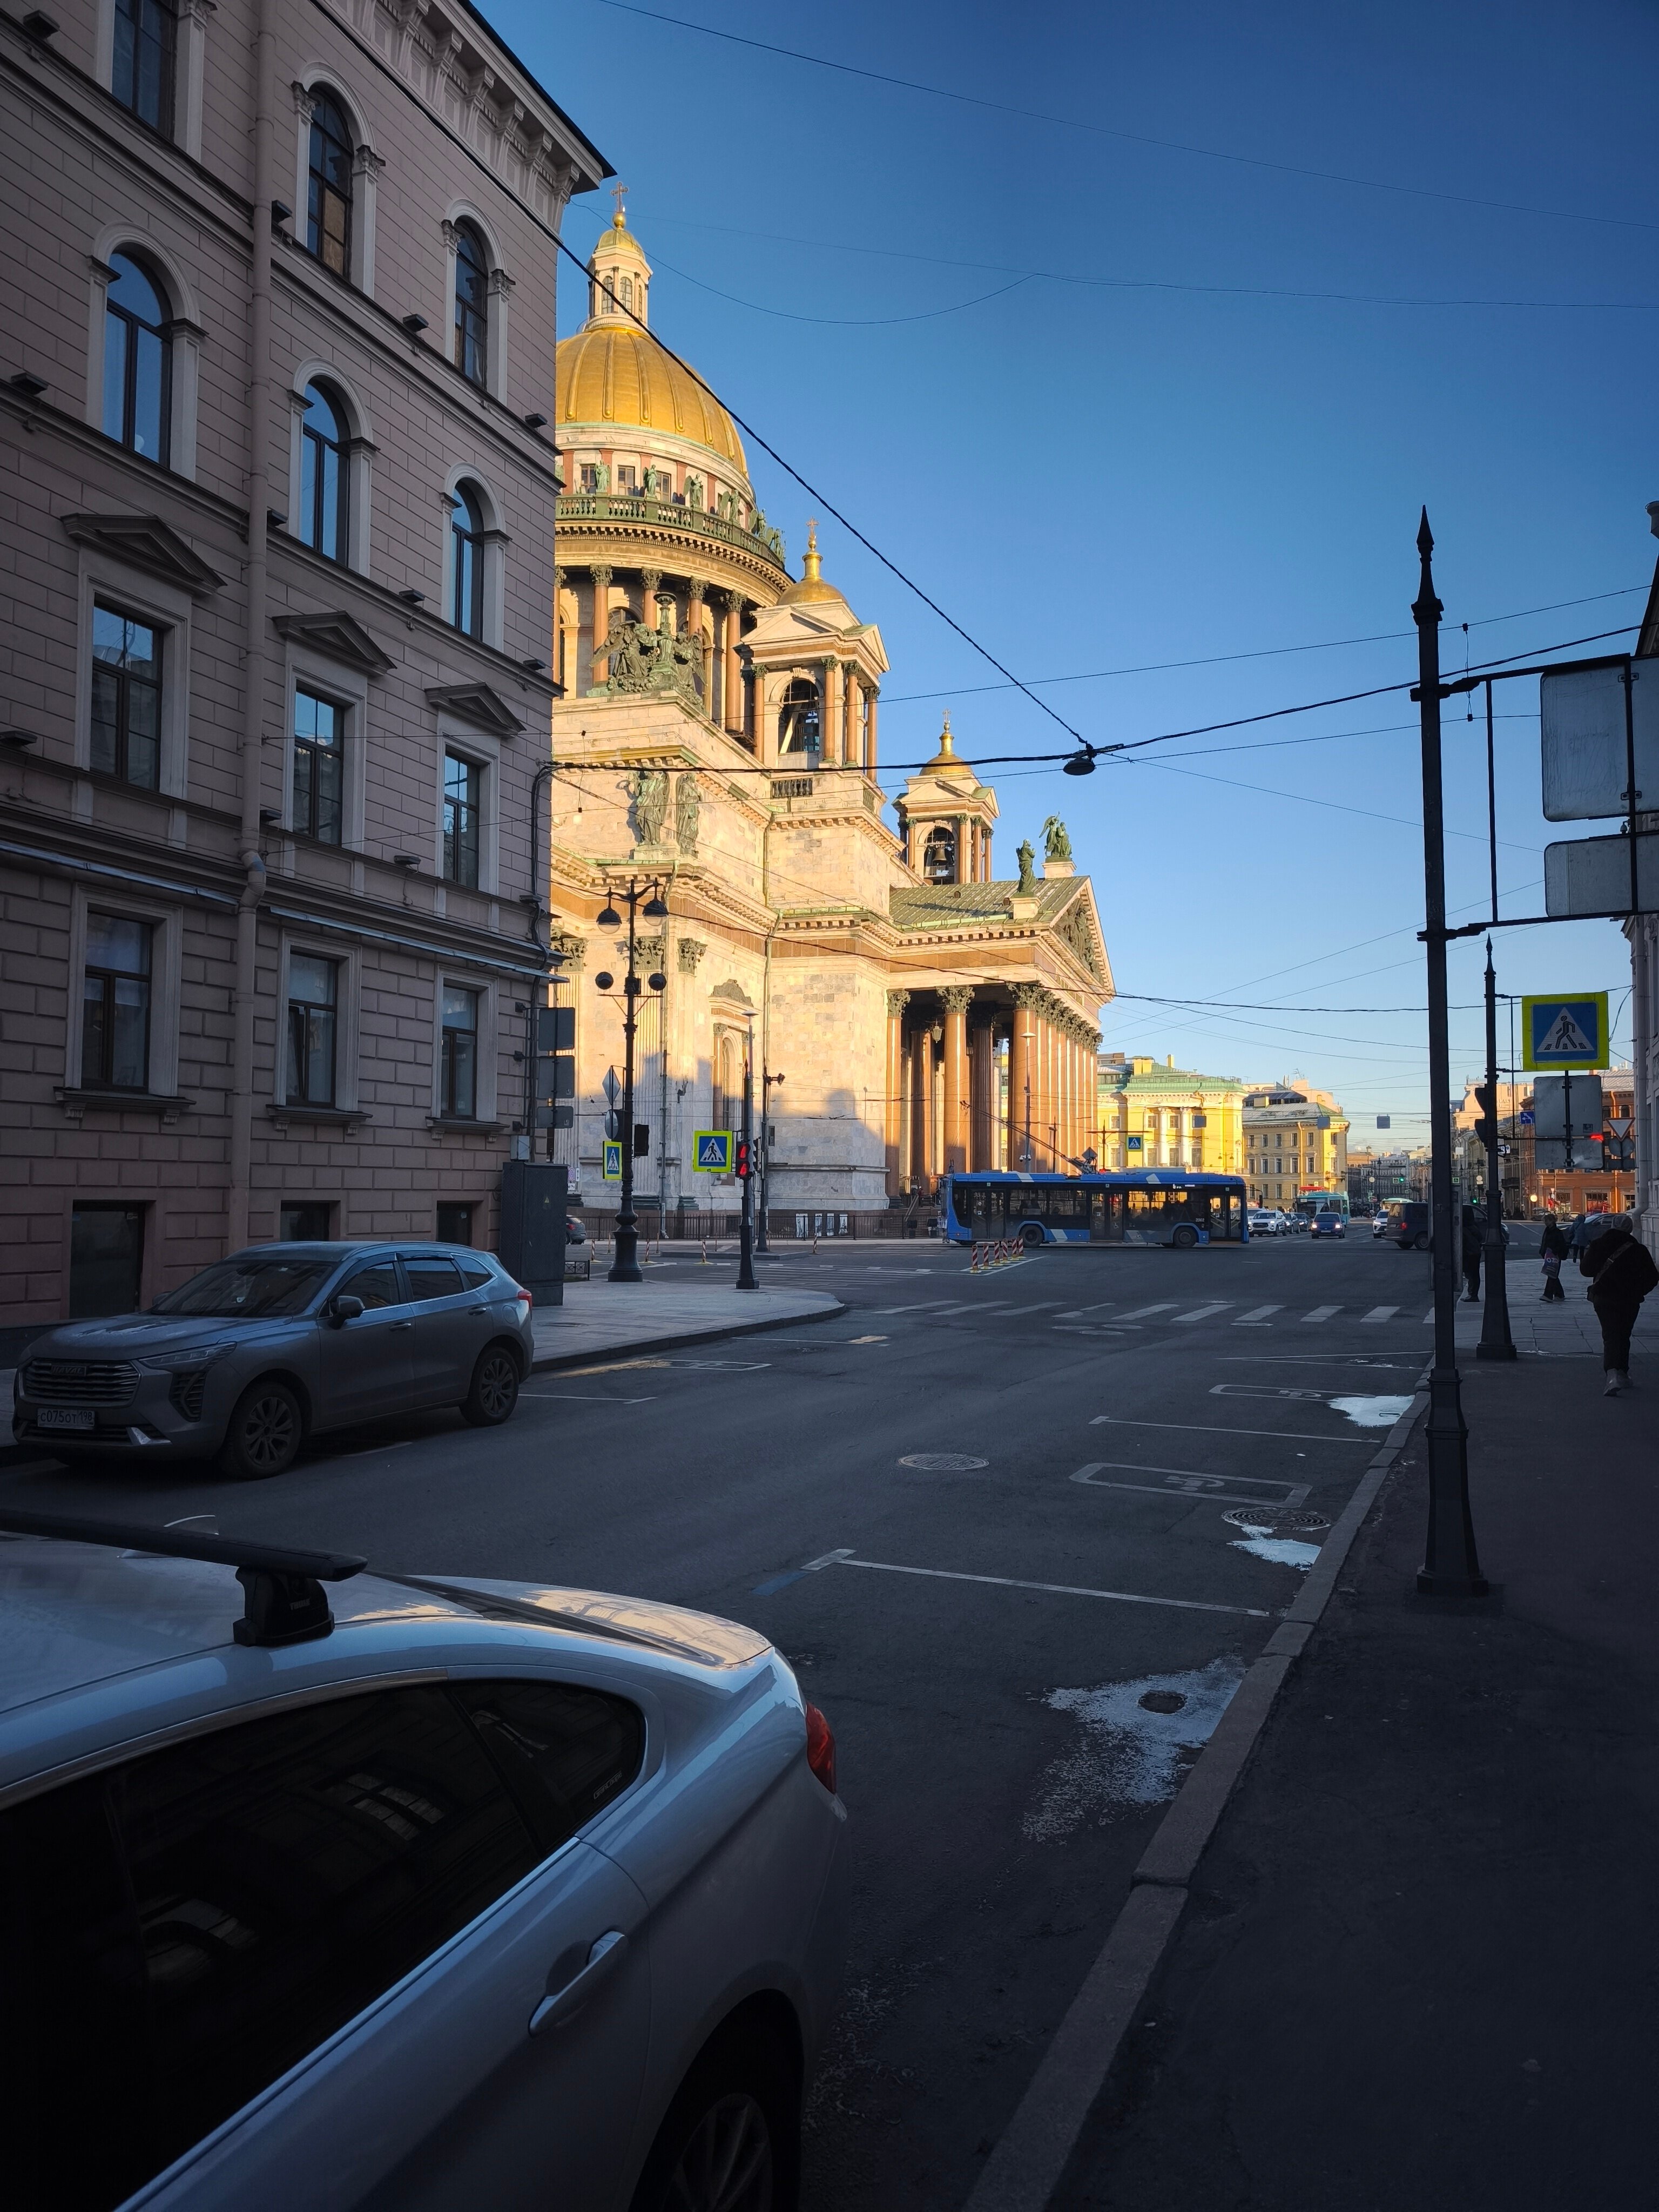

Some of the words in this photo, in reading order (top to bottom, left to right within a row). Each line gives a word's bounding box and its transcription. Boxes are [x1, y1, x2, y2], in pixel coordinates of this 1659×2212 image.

[52, 1366, 83, 1374] HAVAL
[41, 1410, 77, 1424] С075ОТ
[78, 1411, 92, 1421] 198
[289, 1598, 311, 1610] THULE
